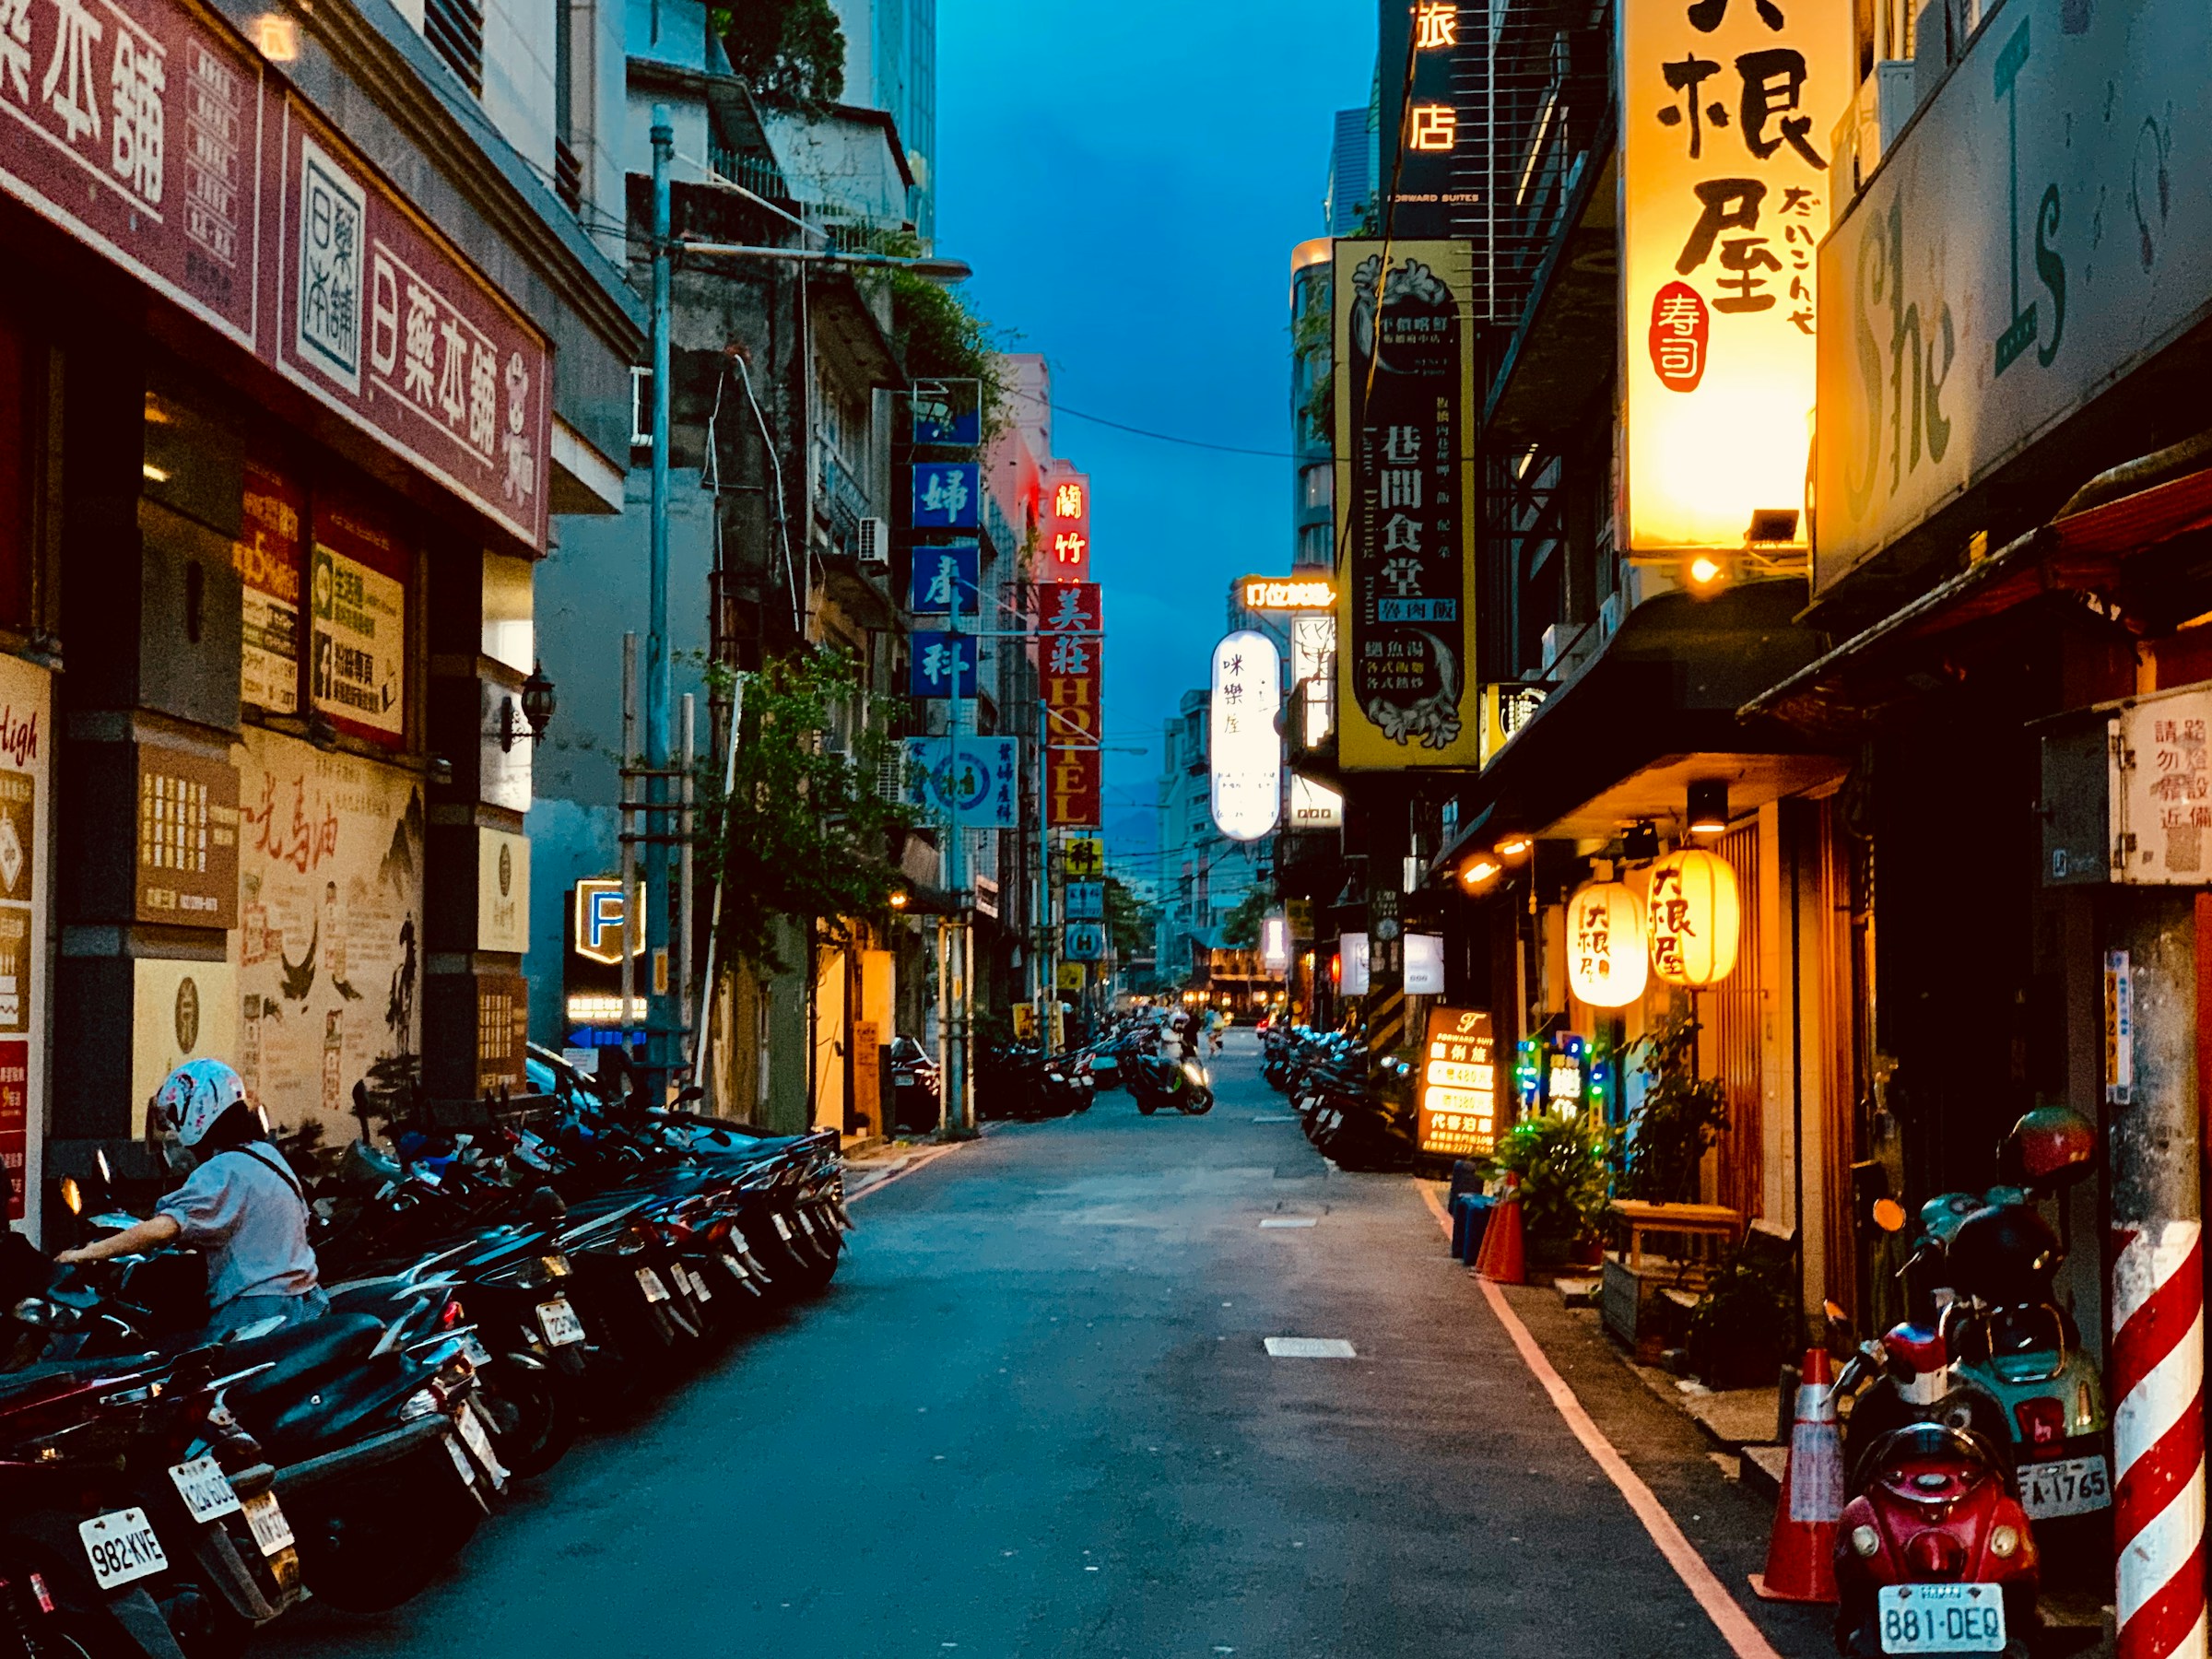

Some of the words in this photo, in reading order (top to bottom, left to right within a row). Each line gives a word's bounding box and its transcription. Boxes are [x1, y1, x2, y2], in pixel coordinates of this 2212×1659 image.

[1409, 3, 1456, 149] 旅店
[1779, 186, 1822, 335] だいこんや
[922, 470, 971, 688] 婦產科
[1055, 484, 1086, 583] 蘭竹
[1381, 425, 1425, 597] 巷間食堂
[1052, 679, 1094, 823] HOTEL
[1649, 865, 1696, 974] 大根屋
[1436, 1032, 1475, 1043] FORWARD
[91, 1528, 164, 1578] 982-KVE
